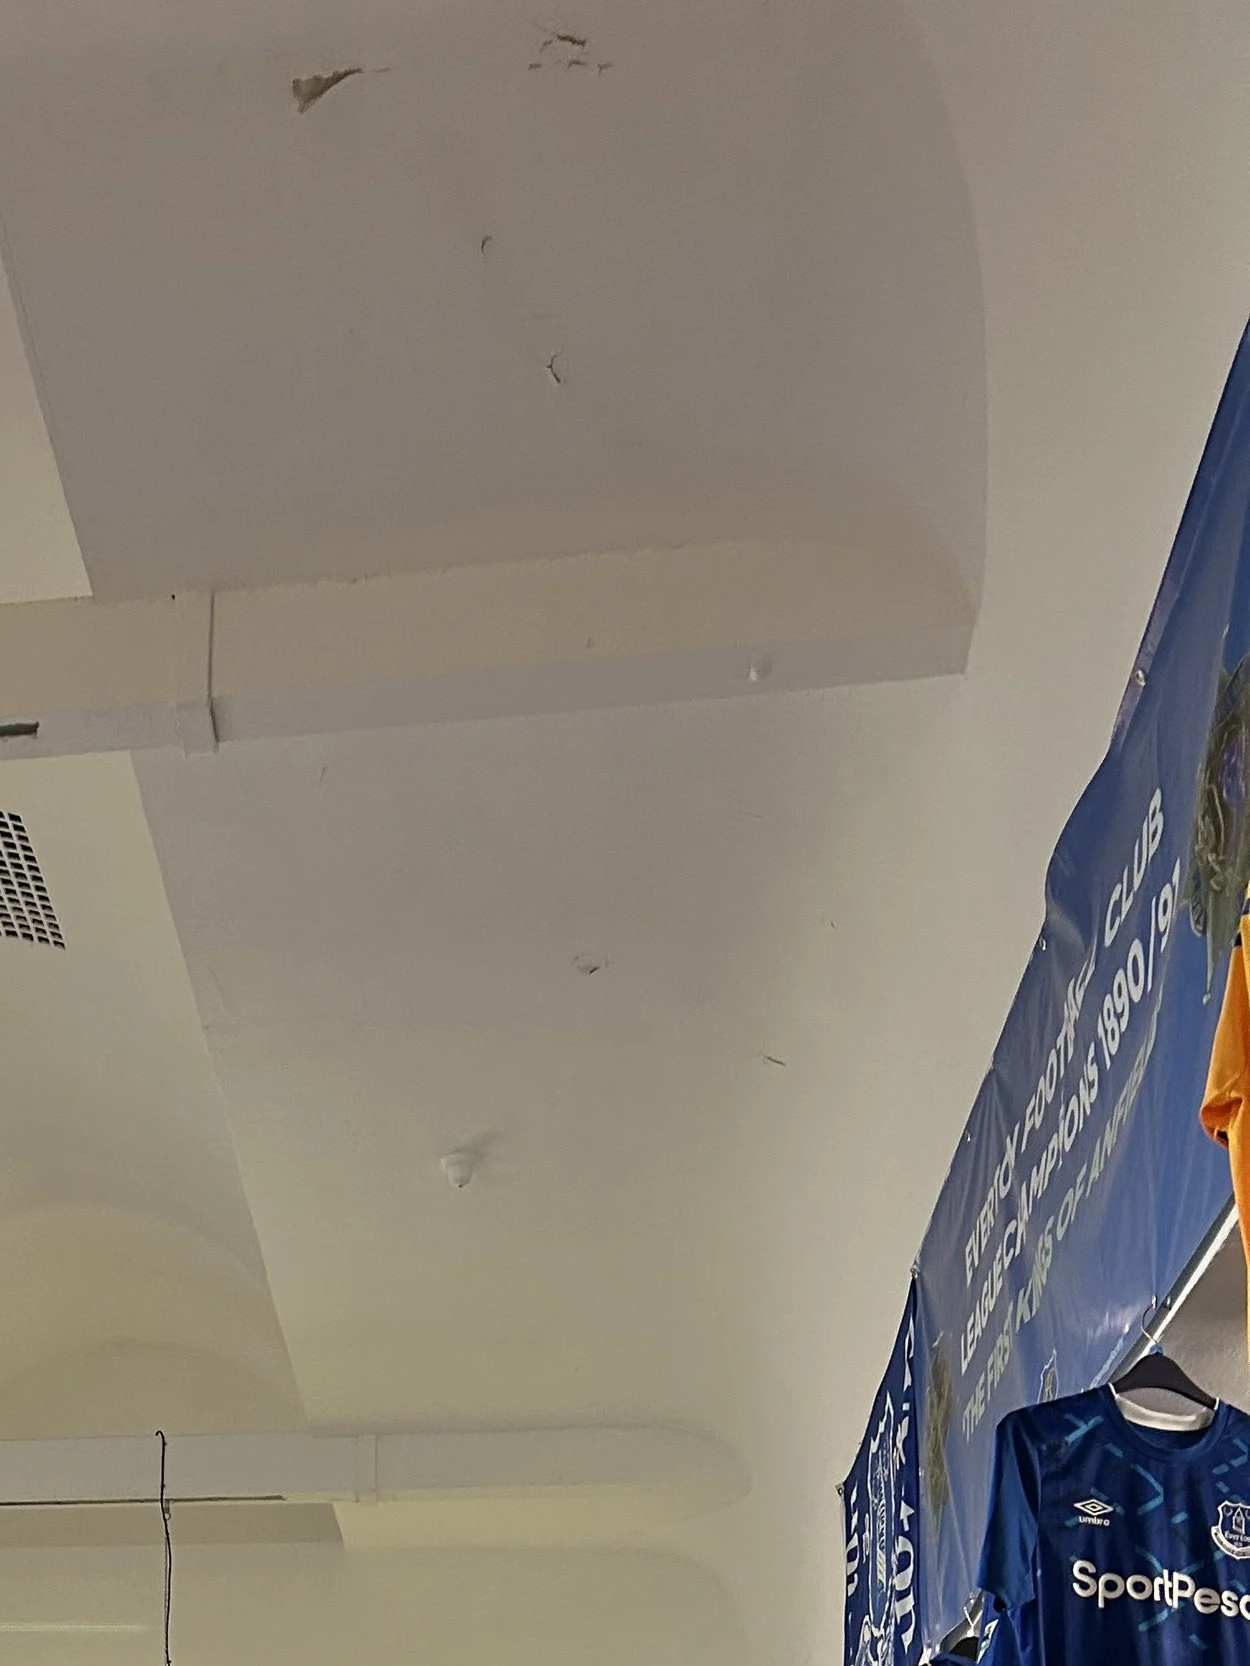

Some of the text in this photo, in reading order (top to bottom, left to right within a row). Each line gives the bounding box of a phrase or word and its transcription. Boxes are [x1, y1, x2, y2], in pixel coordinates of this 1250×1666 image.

[1103, 787, 1164, 948] CLUB
[961, 1241, 1003, 1377] LEAGUE
[1078, 1515, 1111, 1527] umbro
